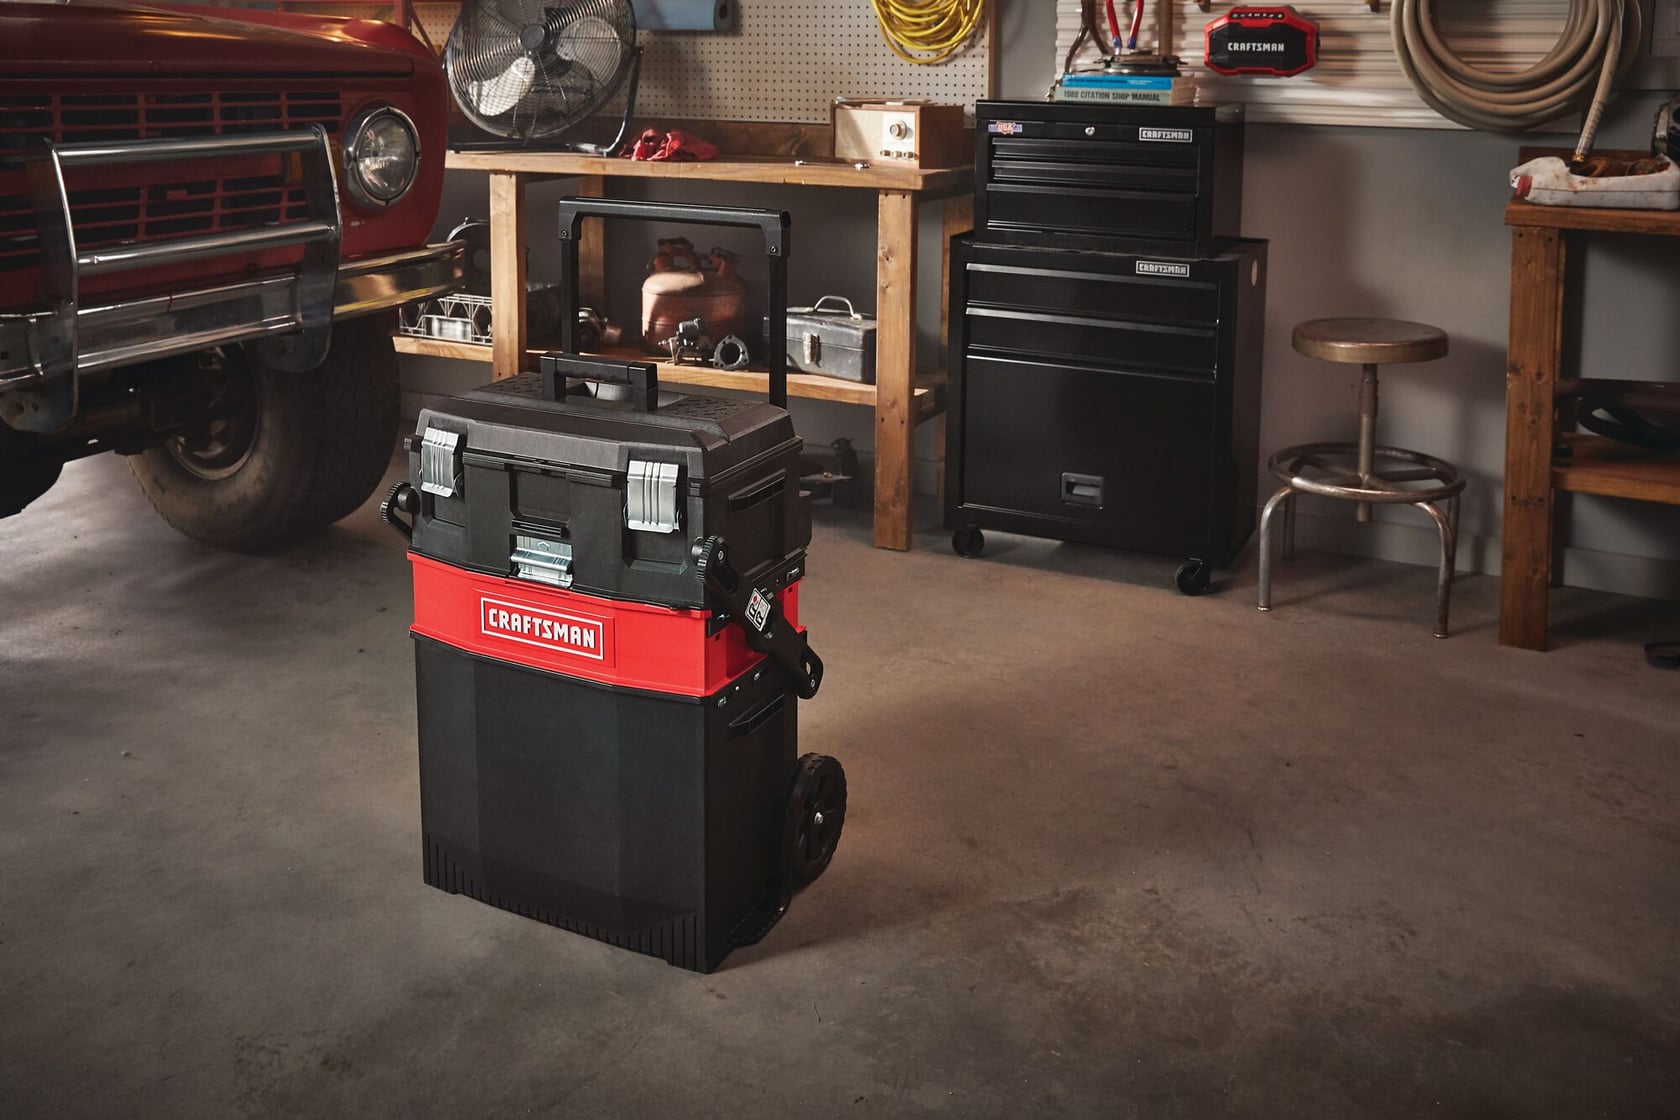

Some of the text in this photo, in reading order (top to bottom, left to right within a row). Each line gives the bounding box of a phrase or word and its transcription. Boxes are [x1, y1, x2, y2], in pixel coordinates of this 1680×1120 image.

[1227, 42, 1285, 52] CRAFTSMAN
[1080, 91, 1110, 99] CITATION
[1112, 92, 1129, 100] SHOP
[1131, 92, 1161, 101] MANUAL
[1142, 130, 1189, 140] CRAFTSMAN
[1139, 263, 1187, 275] CRAFTSMAN
[488, 608, 595, 649] CRAFTSMAN
